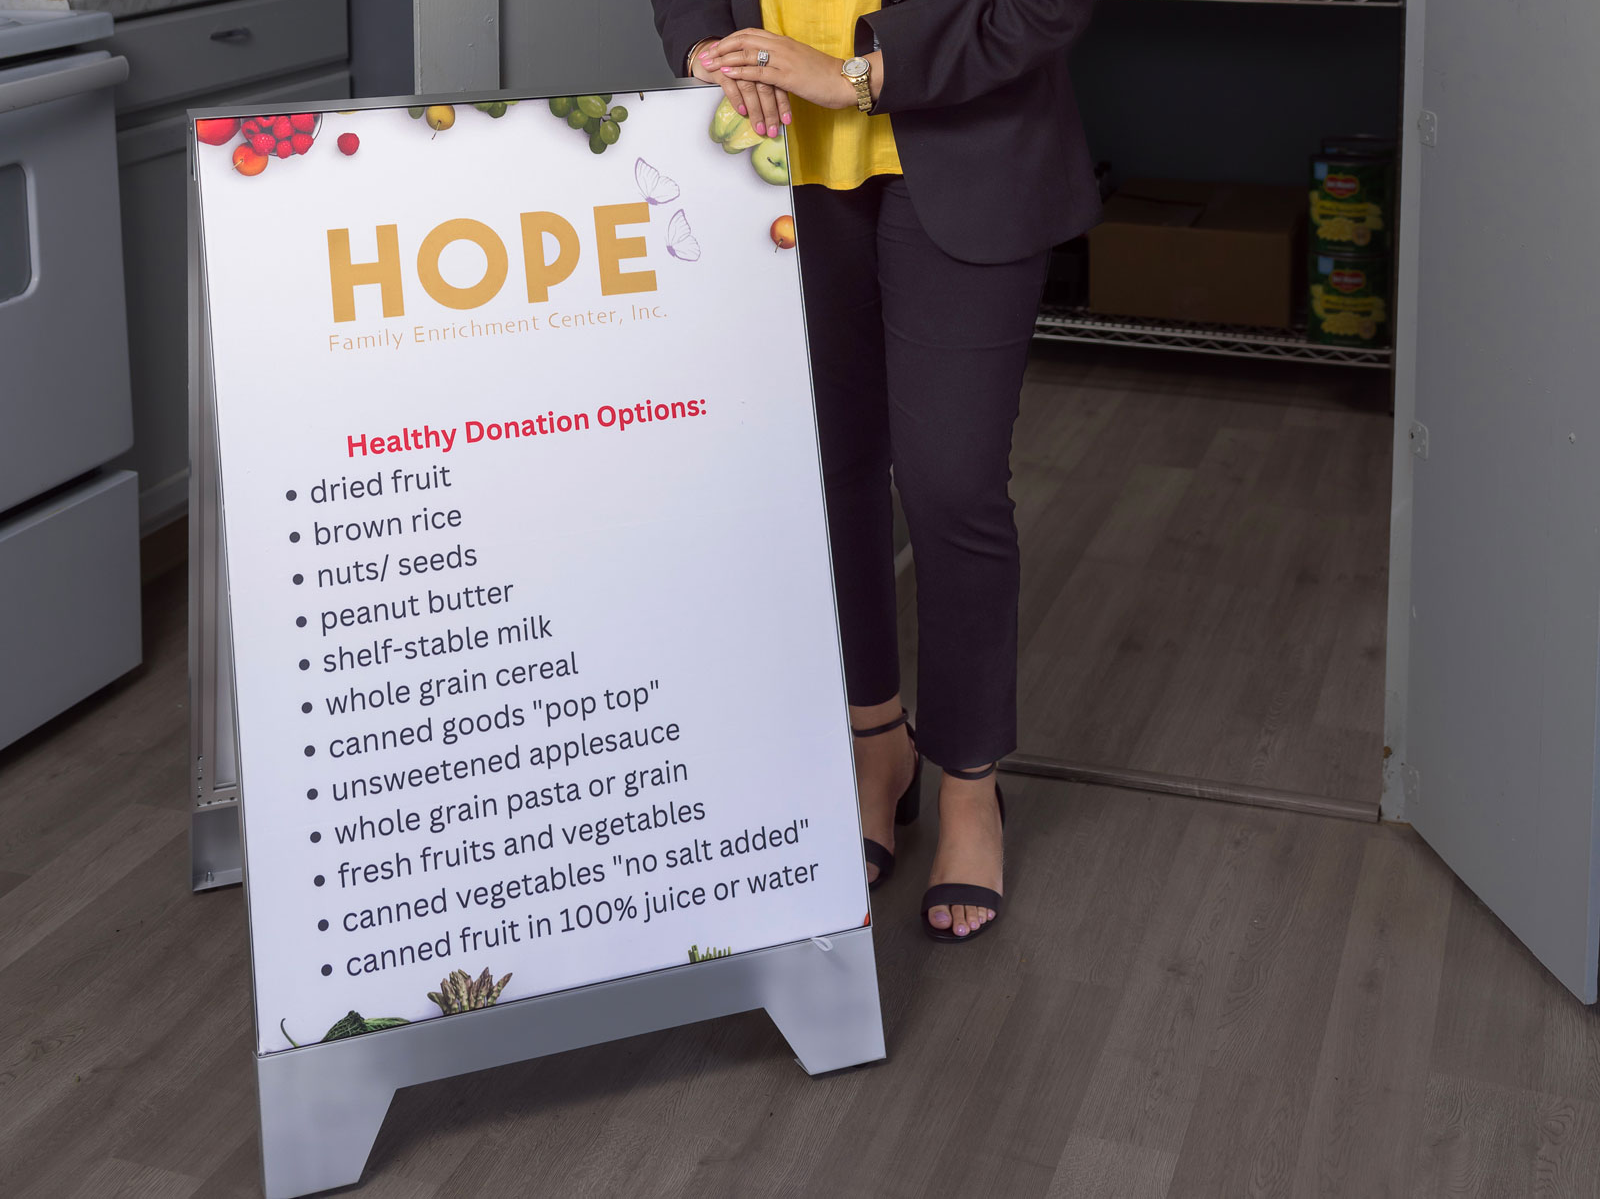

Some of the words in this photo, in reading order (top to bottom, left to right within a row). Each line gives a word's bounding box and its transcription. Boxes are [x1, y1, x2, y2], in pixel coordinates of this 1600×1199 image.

[327, 201, 658, 324] HOPE
[328, 328, 404, 351] Family
[414, 315, 540, 343] Enrichment
[548, 306, 624, 330] Center,
[632, 305, 667, 322] Inc.
[347, 425, 457, 458] Healthy
[465, 411, 589, 443] Donation
[597, 399, 706, 431] Options:
[311, 472, 383, 503] dried
[391, 465, 452, 493] fruit
[314, 517, 402, 545] brown
[412, 507, 461, 532] rice
[318, 554, 389, 587] nuts/
[399, 544, 477, 576] seeds
[321, 596, 420, 637] peanut
[428, 584, 513, 614] butter
[324, 626, 488, 672] shelf-stable
[498, 615, 552, 645] milk
[325, 681, 410, 715] whole
[420, 669, 486, 706] grain
[496, 651, 579, 686] cereal
[329, 717, 432, 758] canned
[443, 704, 525, 745] goods
[533, 696, 596, 727] "pop
[603, 680, 658, 712] top"
[333, 744, 520, 801] unsweetened
[530, 723, 680, 770] applesauce
[335, 809, 420, 844] whole
[430, 795, 497, 833] grain
[507, 782, 581, 819] pasta
[589, 776, 616, 797] or
[625, 760, 687, 797] grain
[338, 852, 412, 889] fresh
[420, 840, 495, 872] fruits
[504, 824, 553, 856] and
[562, 801, 705, 845] vegetables
[343, 888, 447, 932] canned
[456, 863, 605, 909] vegetables
[613, 854, 657, 876] "no
[666, 839, 713, 868] salt
[720, 819, 808, 858] added"
[347, 931, 451, 976] canned
[459, 920, 521, 953] fruit
[528, 914, 551, 939] in
[560, 896, 637, 933] 100%
[644, 887, 705, 923] juice
[714, 879, 740, 901] or
[747, 863, 819, 894] water
